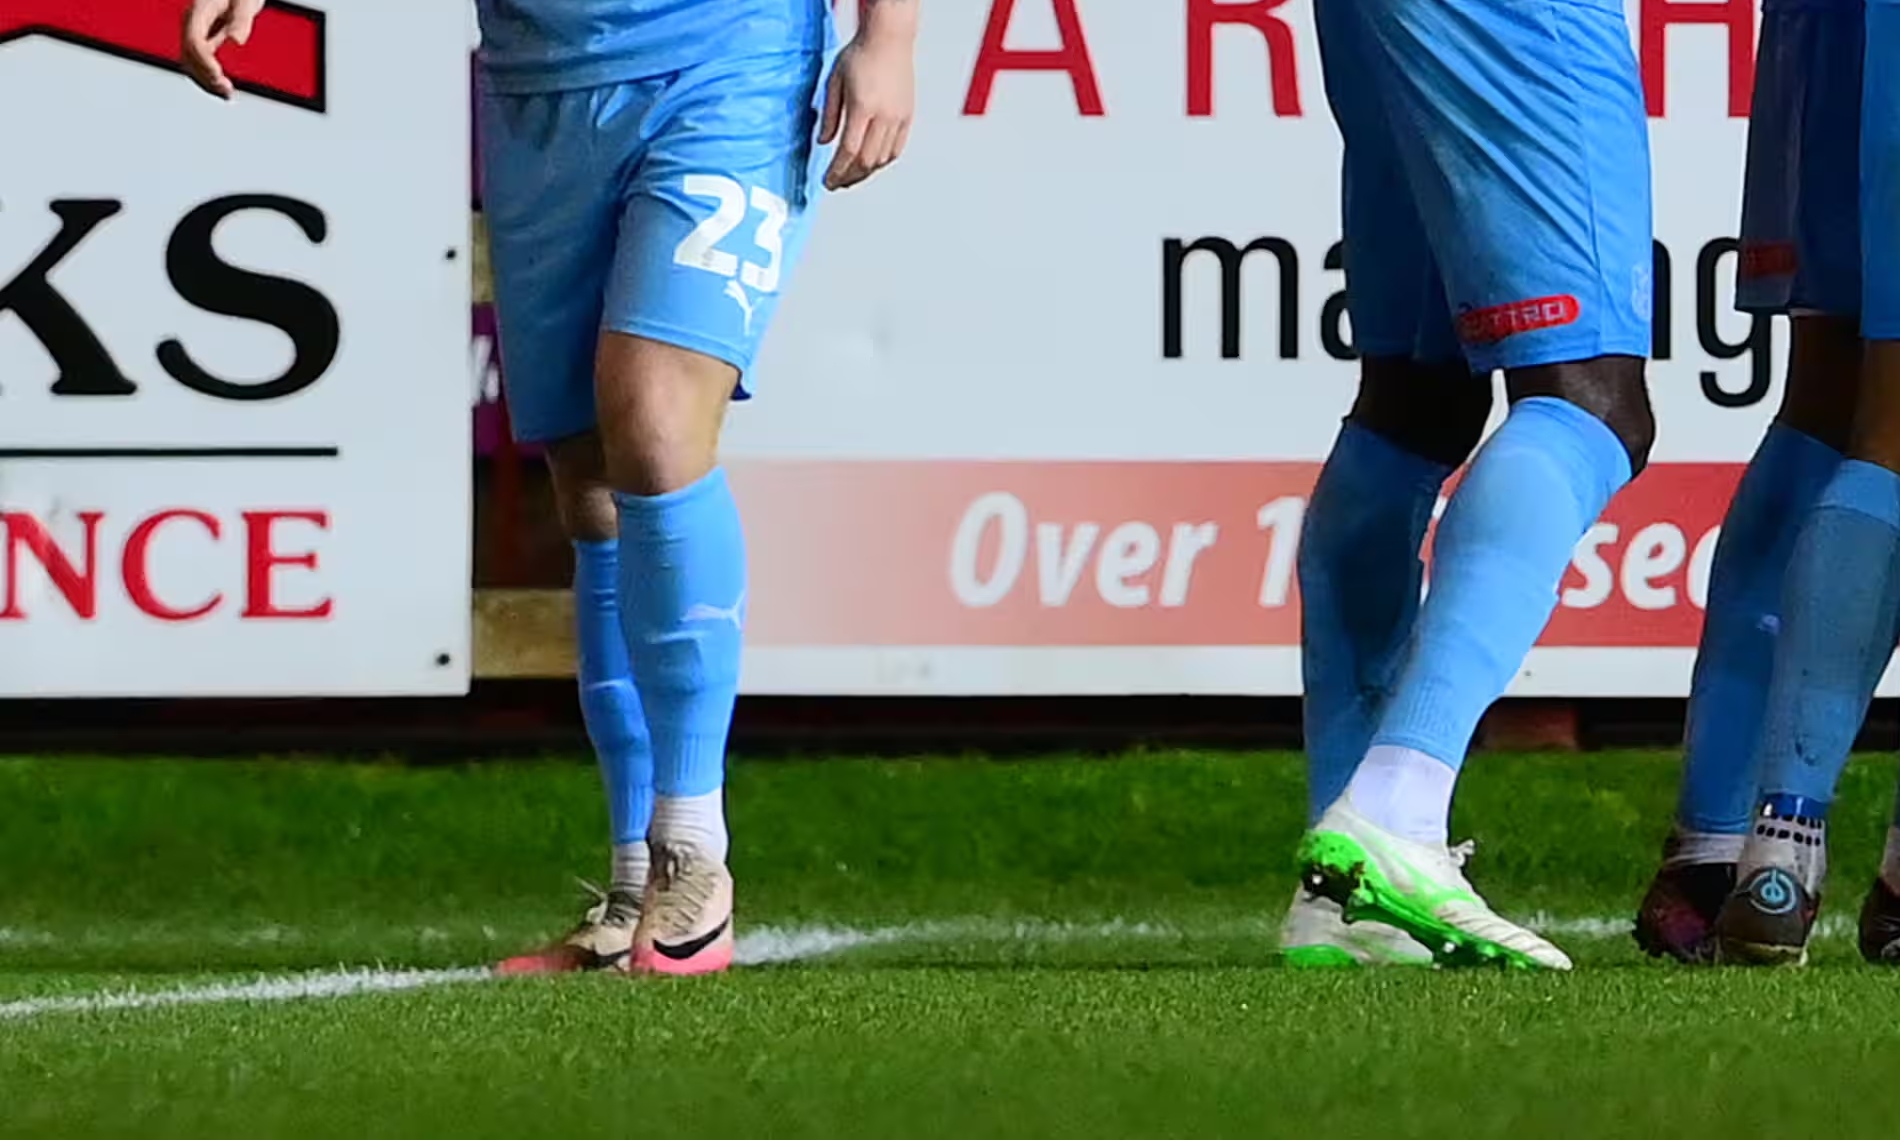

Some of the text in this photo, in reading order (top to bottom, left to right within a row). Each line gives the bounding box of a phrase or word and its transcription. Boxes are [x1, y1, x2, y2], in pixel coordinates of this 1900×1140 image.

[673, 174, 789, 293] 23
[0, 193, 341, 400] KS
[0, 509, 334, 620] NCE
[949, 492, 1216, 608] Over
